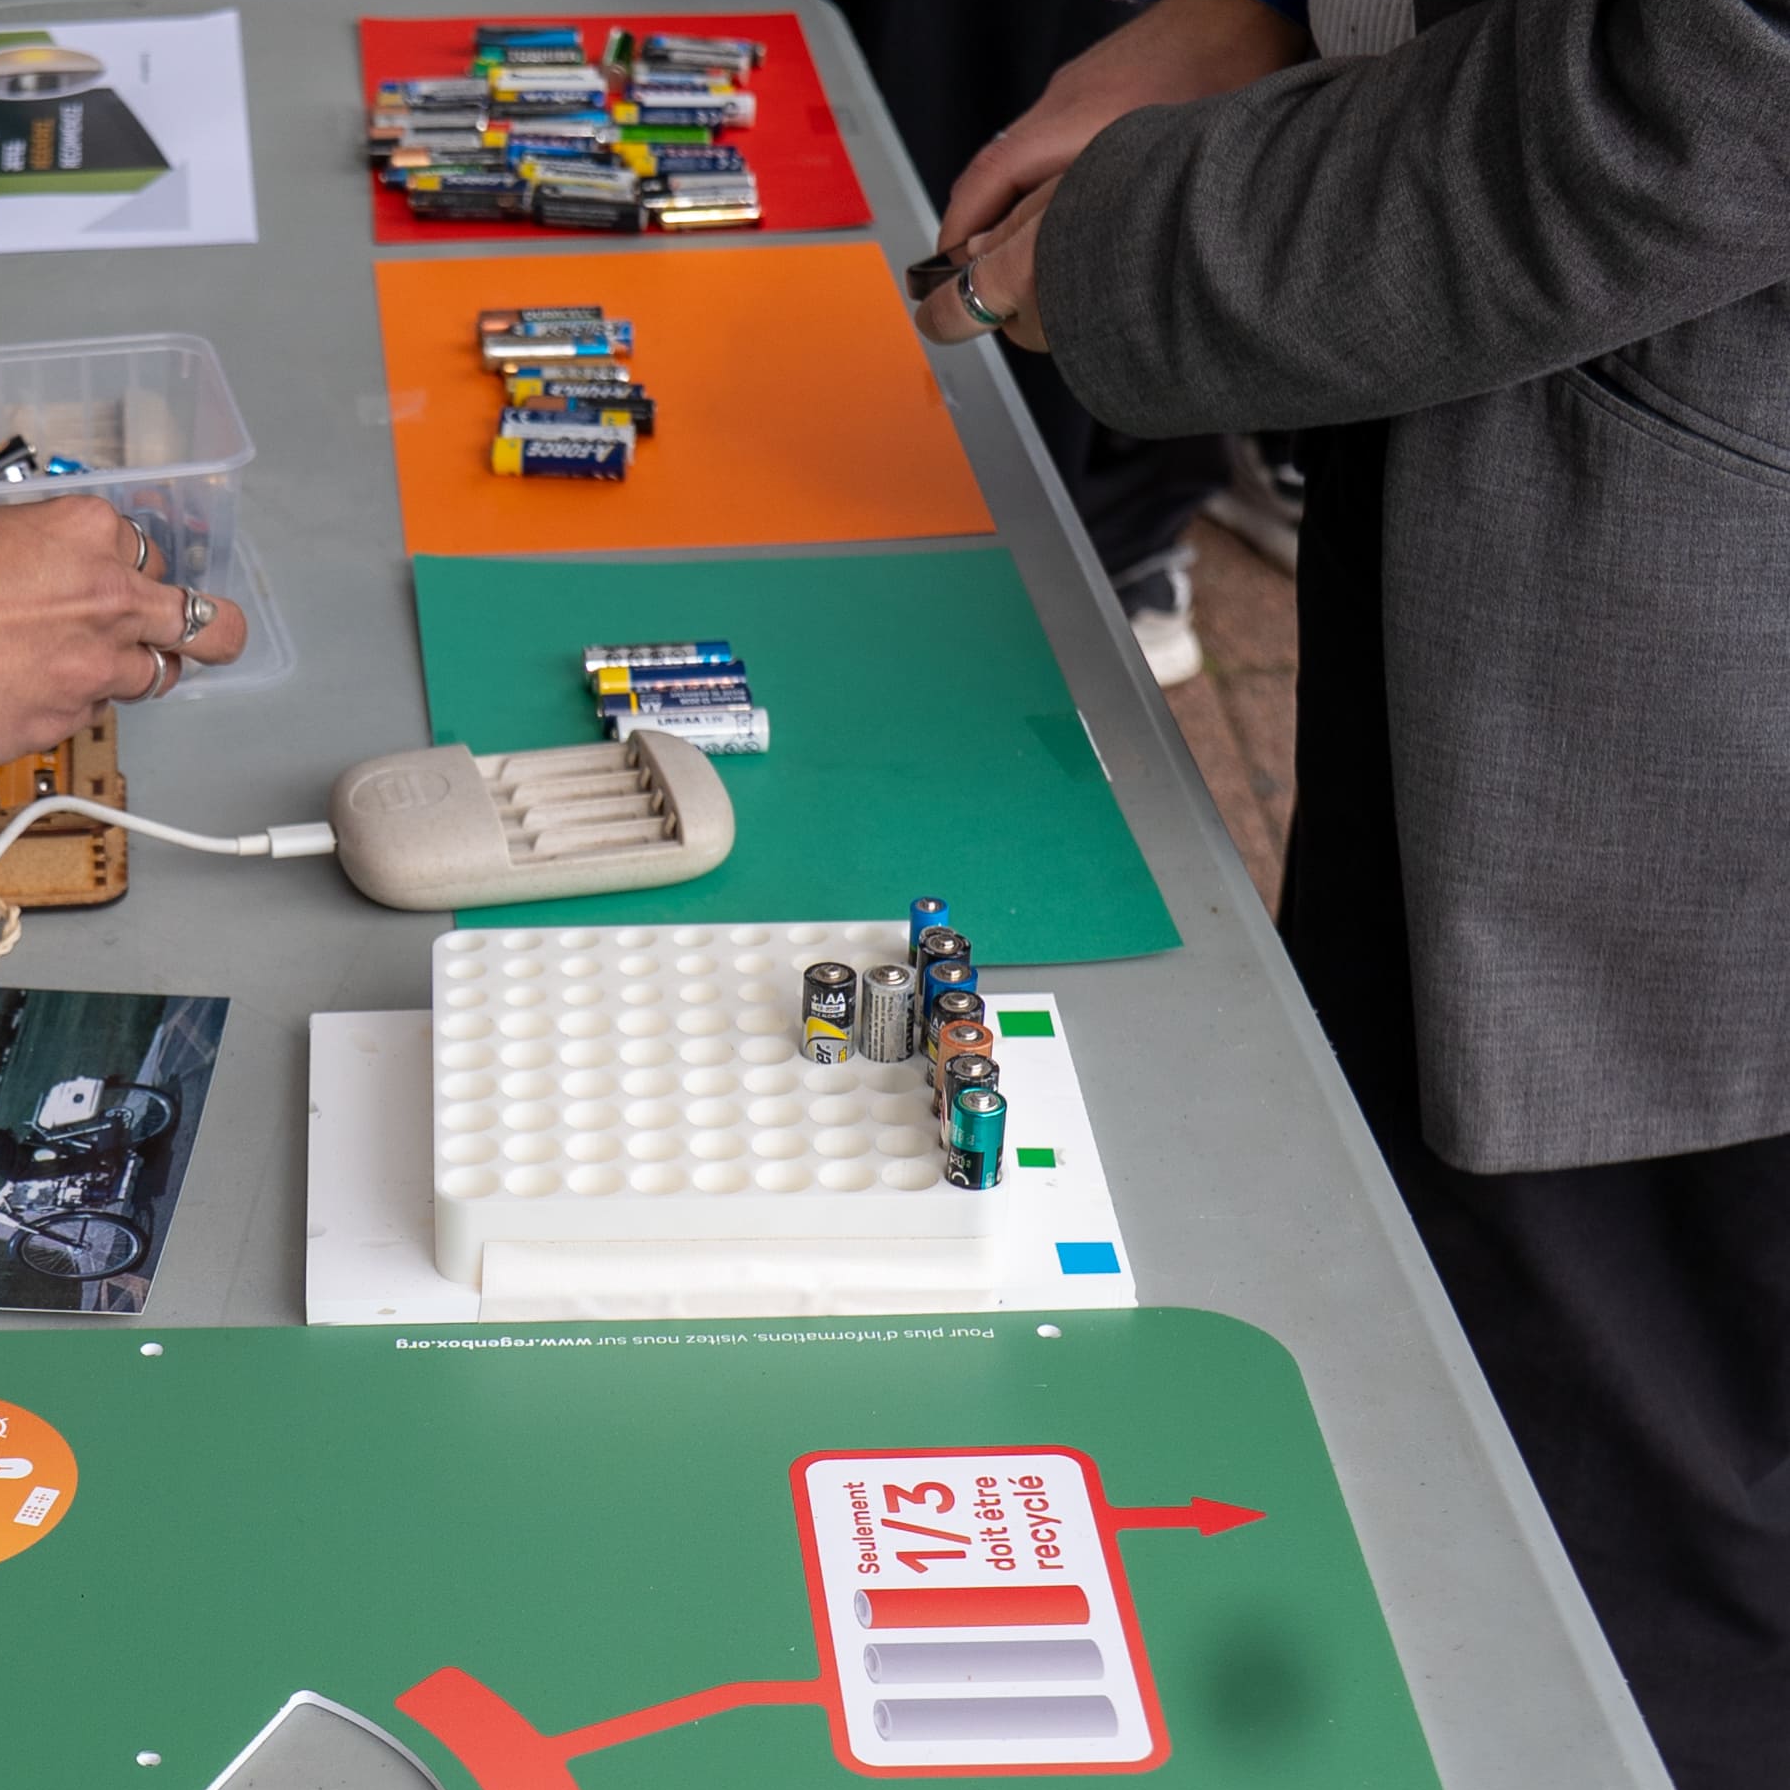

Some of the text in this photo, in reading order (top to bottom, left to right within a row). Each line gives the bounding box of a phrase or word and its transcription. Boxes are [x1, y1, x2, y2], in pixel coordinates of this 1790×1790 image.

[826, 992, 845, 1004] AA
[632, 1334, 680, 1346] nous
[685, 1332, 748, 1346] visitez
[903, 1326, 944, 1341] plus
[949, 1327, 995, 1340] Pour
[395, 1336, 592, 1351] www.regenbox.org
[596, 1336, 627, 1348] sur
[842, 1481, 880, 1575] Seulement
[880, 1481, 972, 1574] 1/3
[973, 1475, 1017, 1572] doit être
[1007, 1474, 1065, 1571] recyclé
